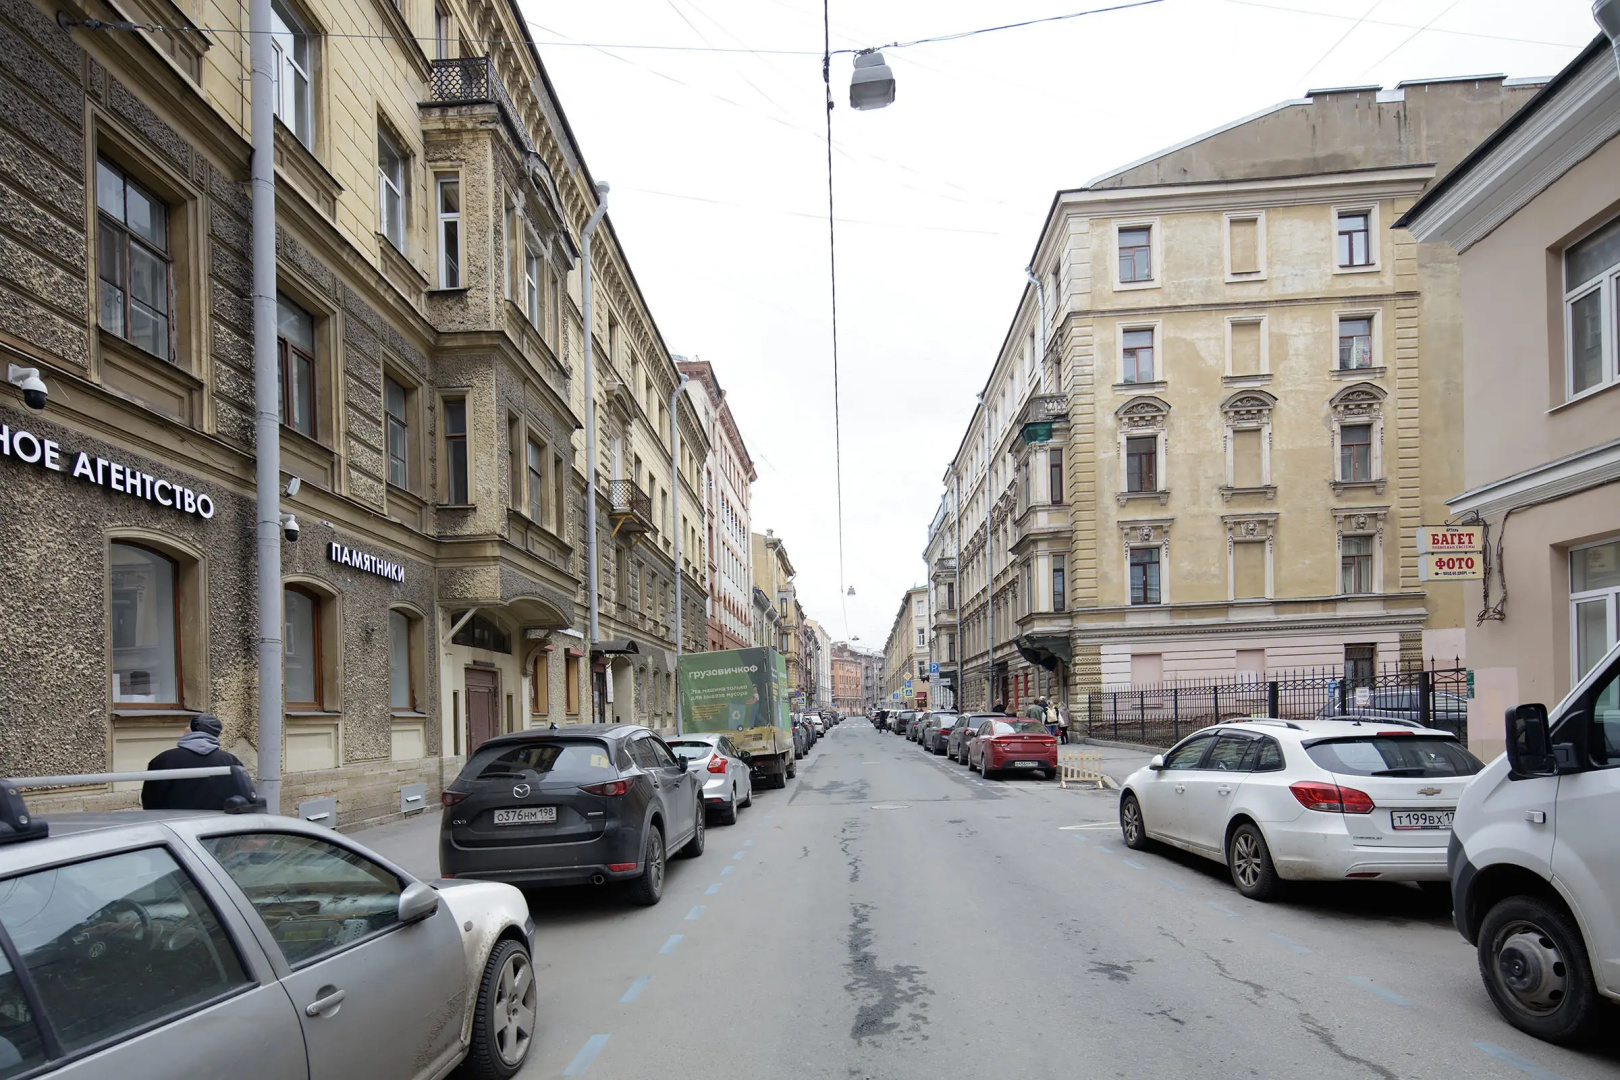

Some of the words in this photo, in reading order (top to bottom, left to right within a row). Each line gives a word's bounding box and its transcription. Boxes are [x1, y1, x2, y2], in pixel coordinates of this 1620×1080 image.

[72, 451, 214, 519] АГЕНТСТВО
[1431, 533, 1475, 545] БАГЕТ
[331, 542, 405, 583] ПАМЯТНИКИ
[1435, 557, 1475, 570] ФОТО
[688, 665, 758, 679] грузовичкоф
[702, 686, 726, 694] машина
[726, 684, 748, 692] только
